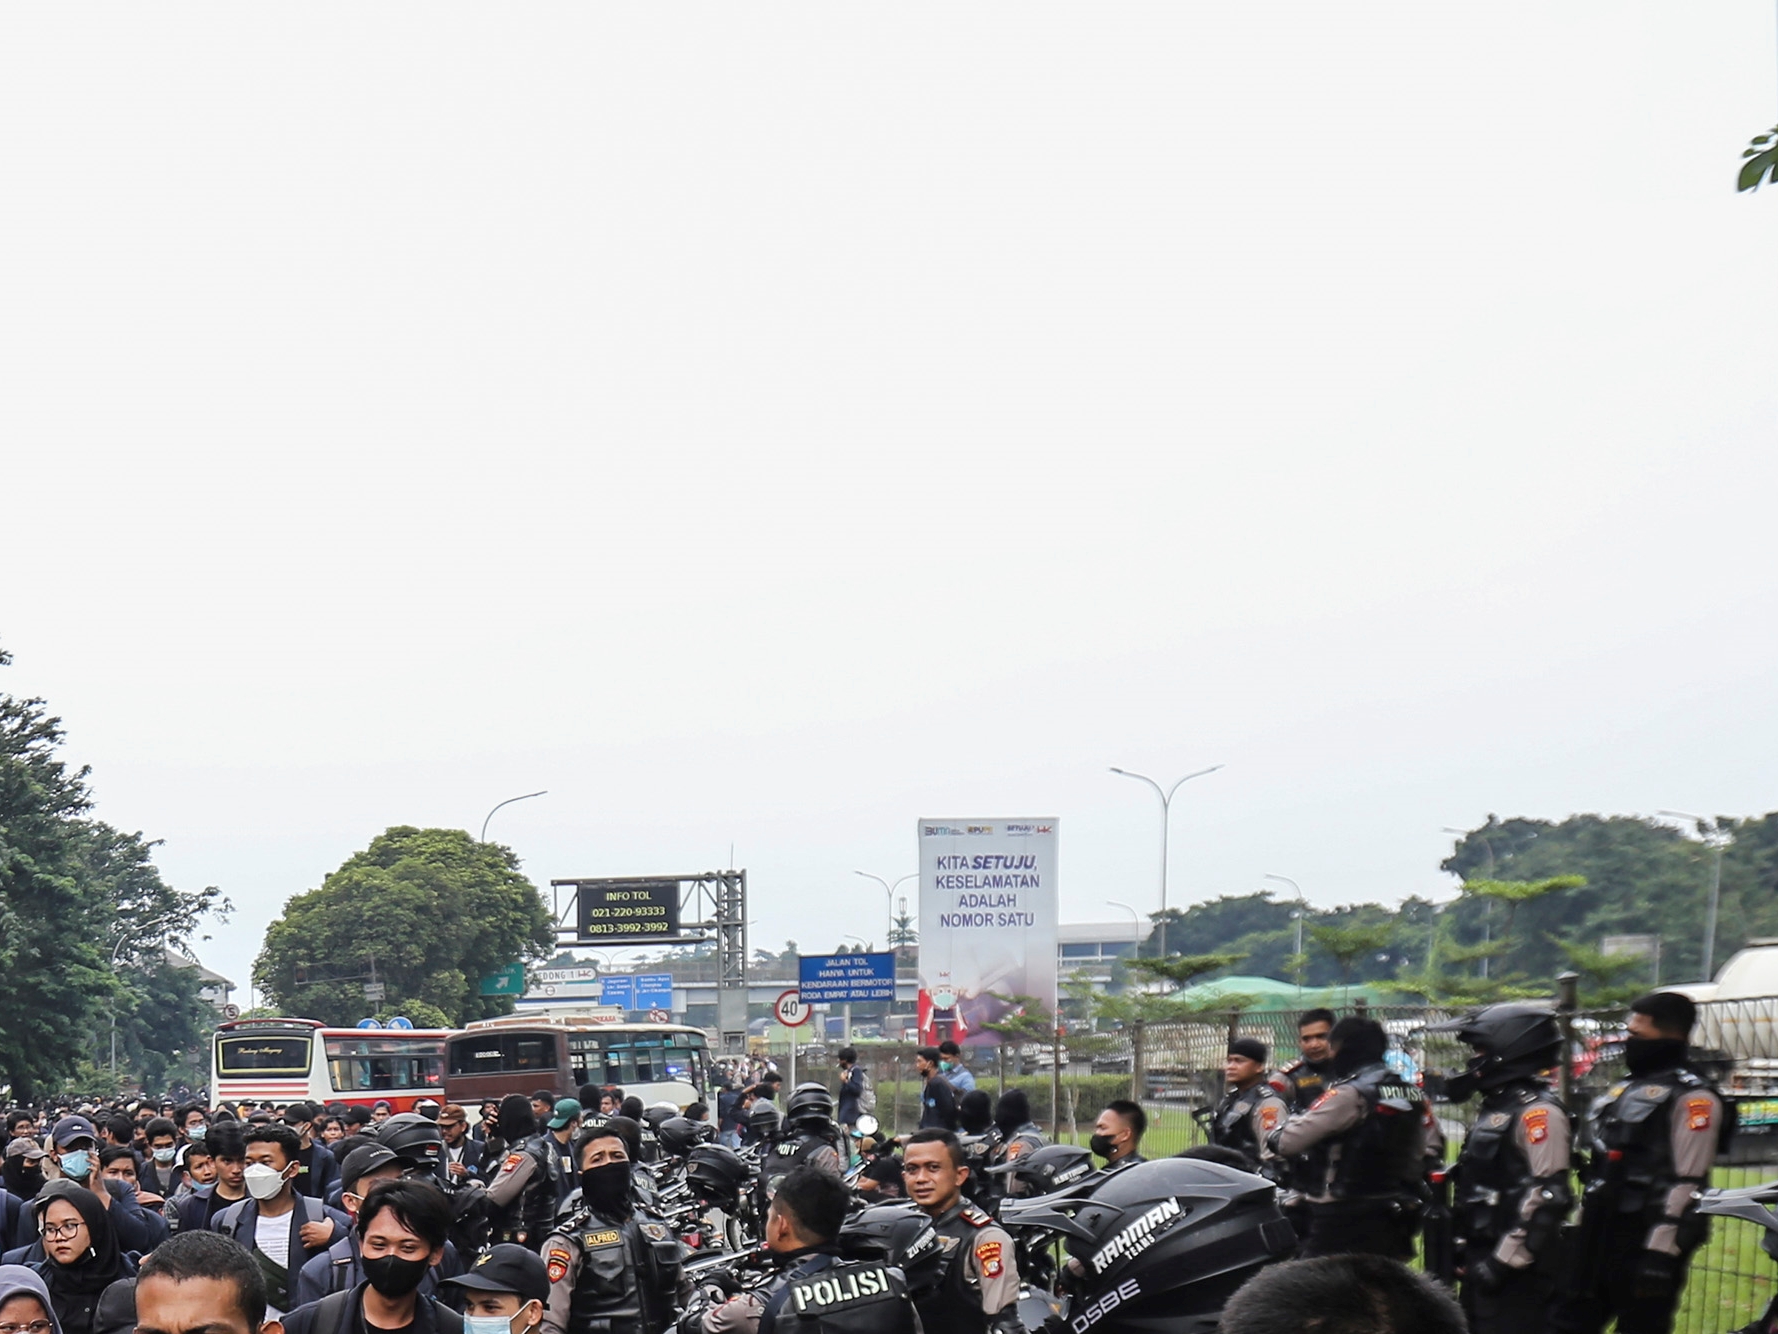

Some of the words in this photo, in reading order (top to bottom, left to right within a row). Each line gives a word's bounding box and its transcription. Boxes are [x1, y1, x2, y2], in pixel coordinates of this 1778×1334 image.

[937, 856, 969, 870] KITA
[971, 855, 1037, 871] SETUJU,
[935, 874, 1040, 889] KESELAMATAN
[606, 892, 630, 901] INFO
[633, 891, 652, 900] TOL
[959, 894, 1016, 908] ADALAH
[592, 907, 665, 918] 021-220-93333
[940, 913, 994, 928] NOMOR
[998, 912, 1034, 927] SATU
[589, 922, 669, 933] 0813-3992-3992
[825, 959, 851, 967] JALAN
[854, 958, 868, 966] TOL
[848, 968, 874, 976] UNTUK
[802, 980, 849, 988] KENDARAAN
[851, 978, 893, 986] BERMOTOR
[802, 991, 822, 999] RODA
[824, 990, 847, 999] EMPAT
[851, 989, 869, 997] ATAU
[871, 988, 893, 996] LEBIH
[781, 1001, 798, 1016] 40
[582, 1118, 608, 1128] POLIS
[1091, 1196, 1182, 1275] RAHMAN
[977, 1243, 999, 1254] POLDA
[1124, 1235, 1157, 1261] TEAMS
[795, 1267, 889, 1311] POLISI
